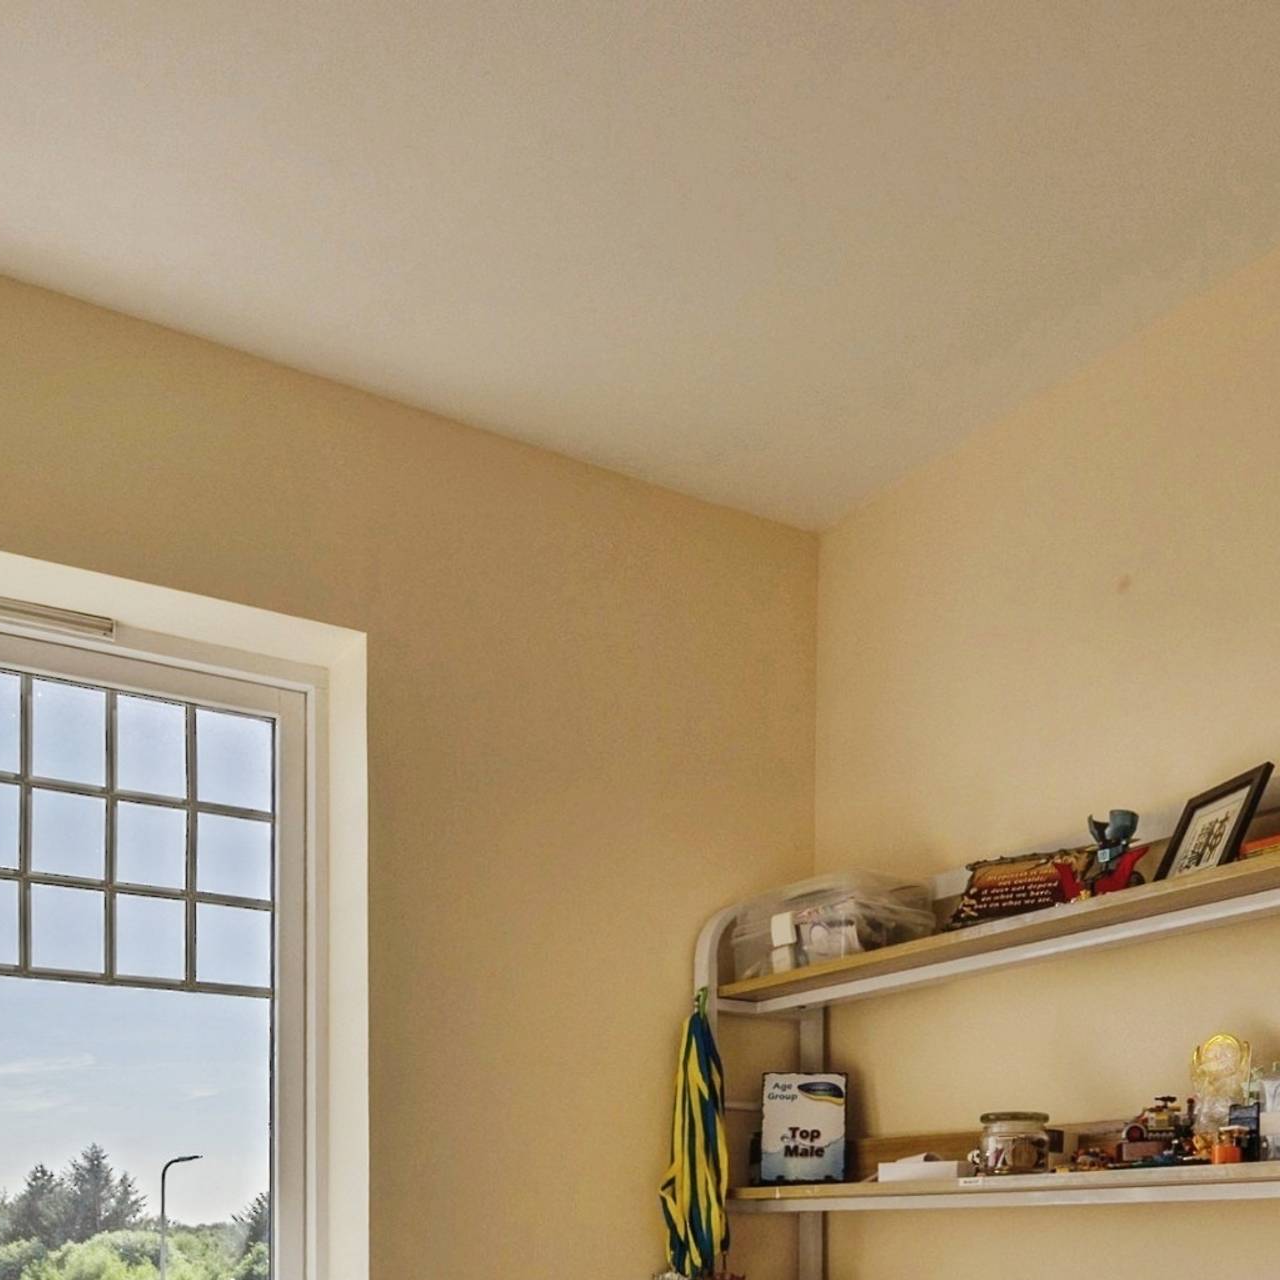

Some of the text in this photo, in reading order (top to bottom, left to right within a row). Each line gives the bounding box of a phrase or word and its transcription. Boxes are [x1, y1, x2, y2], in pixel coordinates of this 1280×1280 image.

[772, 1082, 793, 1092] Age
[767, 1092, 799, 1102] Group
[788, 1126, 822, 1143] Top
[783, 1145, 826, 1158] Male
